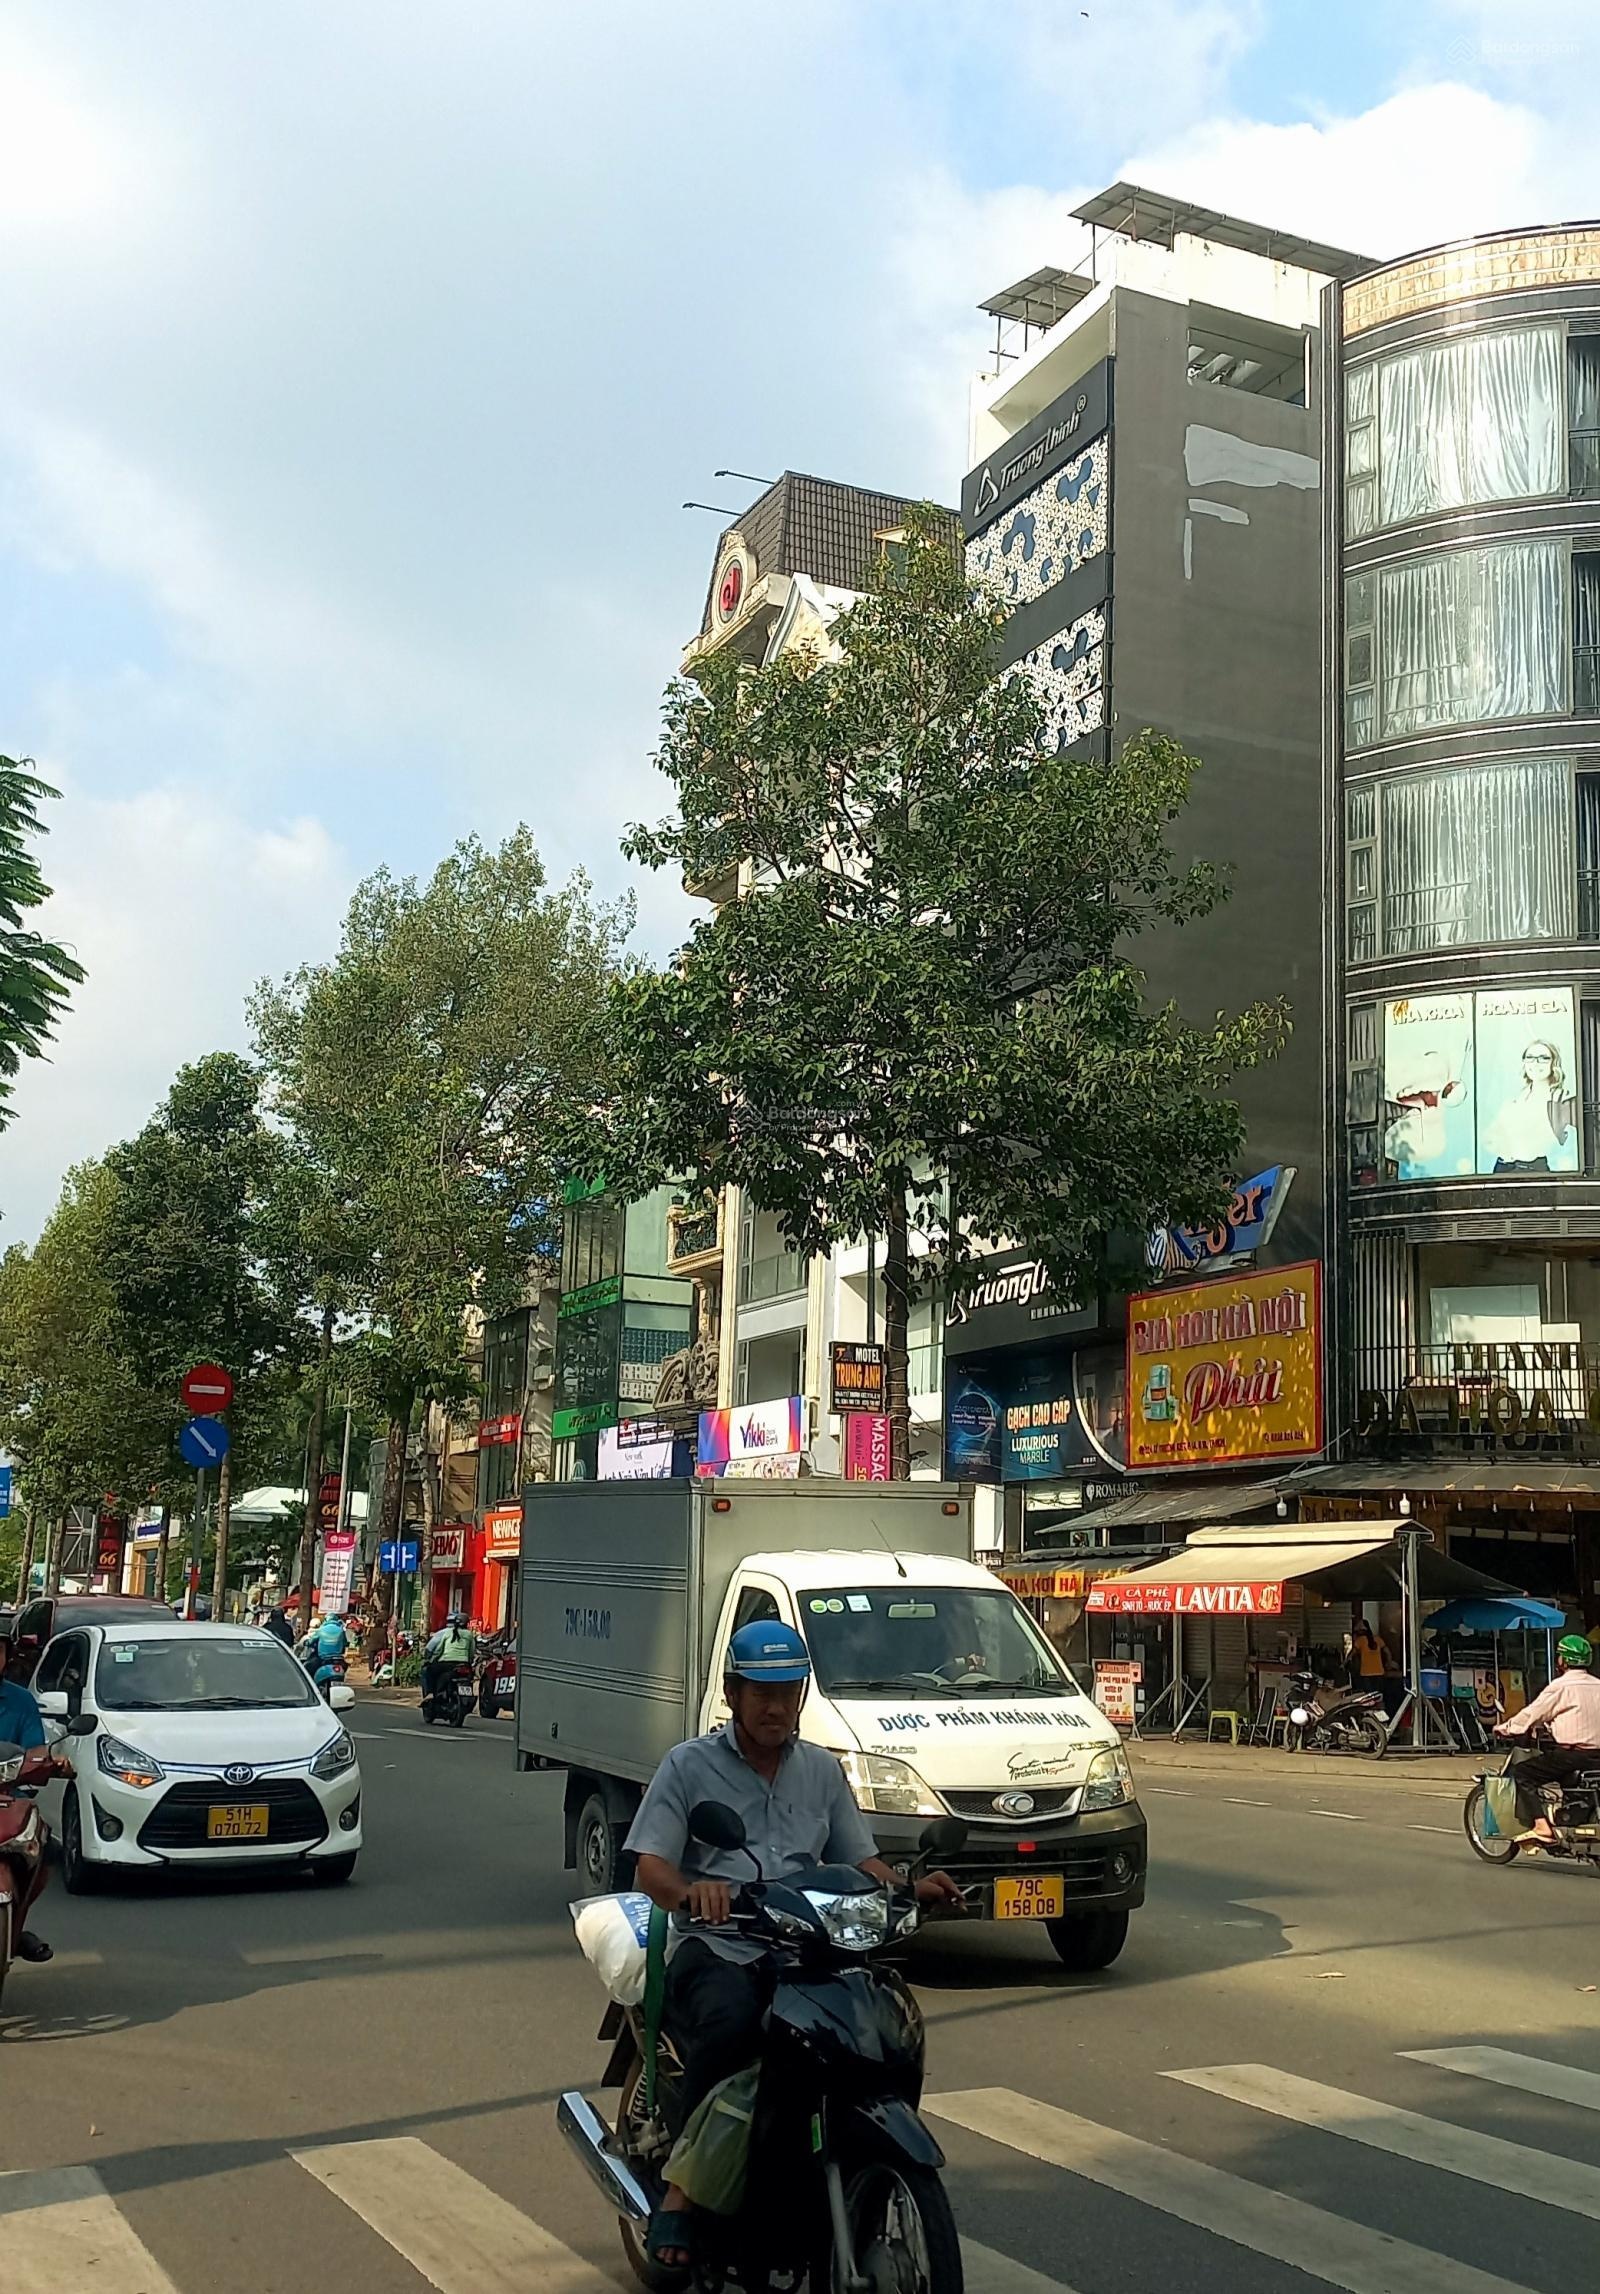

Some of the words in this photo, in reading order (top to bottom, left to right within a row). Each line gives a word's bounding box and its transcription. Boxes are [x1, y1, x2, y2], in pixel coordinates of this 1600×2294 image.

[855, 1347, 881, 1363] MOTEL
[835, 1363, 862, 1388] TRUNG
[864, 1366, 880, 1389] ANH
[1007, 1404, 1029, 1434] GẠCH
[1032, 1402, 1050, 1427] CAO
[1011, 1434, 1059, 1452] LUXURIOUS
[1060, 1574, 1079, 1592] HÀ
[1175, 1586, 1255, 1612] LAVITA
[878, 1713, 930, 1732] DƯỢC
[935, 1706, 991, 1728] PHẨM
[993, 1708, 1051, 1726] KHÁNH
[226, 1808, 252, 1821] 51H
[215, 1822, 261, 1836] 070.72
[1016, 1879, 1043, 1896] 79C
[1005, 1898, 1055, 1916] 158.08
